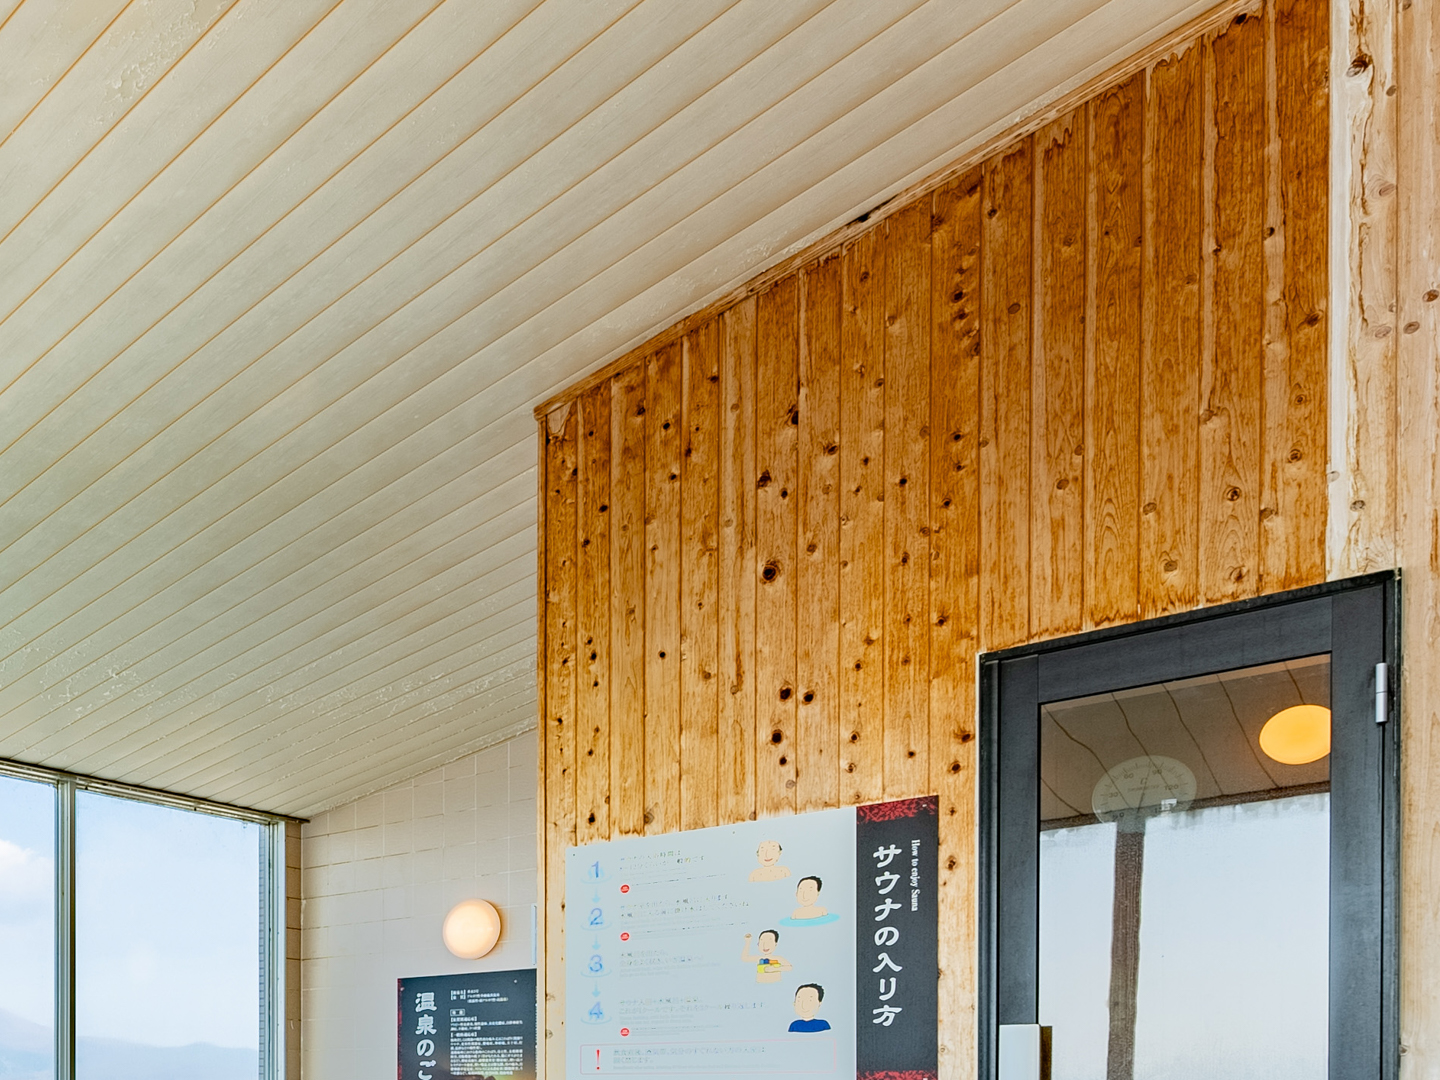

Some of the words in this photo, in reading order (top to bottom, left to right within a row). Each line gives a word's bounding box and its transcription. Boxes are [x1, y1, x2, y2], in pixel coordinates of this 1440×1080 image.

[911, 839, 921, 857] How
[590, 860, 600, 878] 1
[911, 858, 919, 867] to
[909, 867, 921, 888] enjoy
[911, 889, 921, 912] Sauna
[589, 907, 604, 926] 2
[872, 844, 903, 1027] サウナの入り方
[589, 954, 603, 973] 3
[589, 1001, 603, 1019] 4
